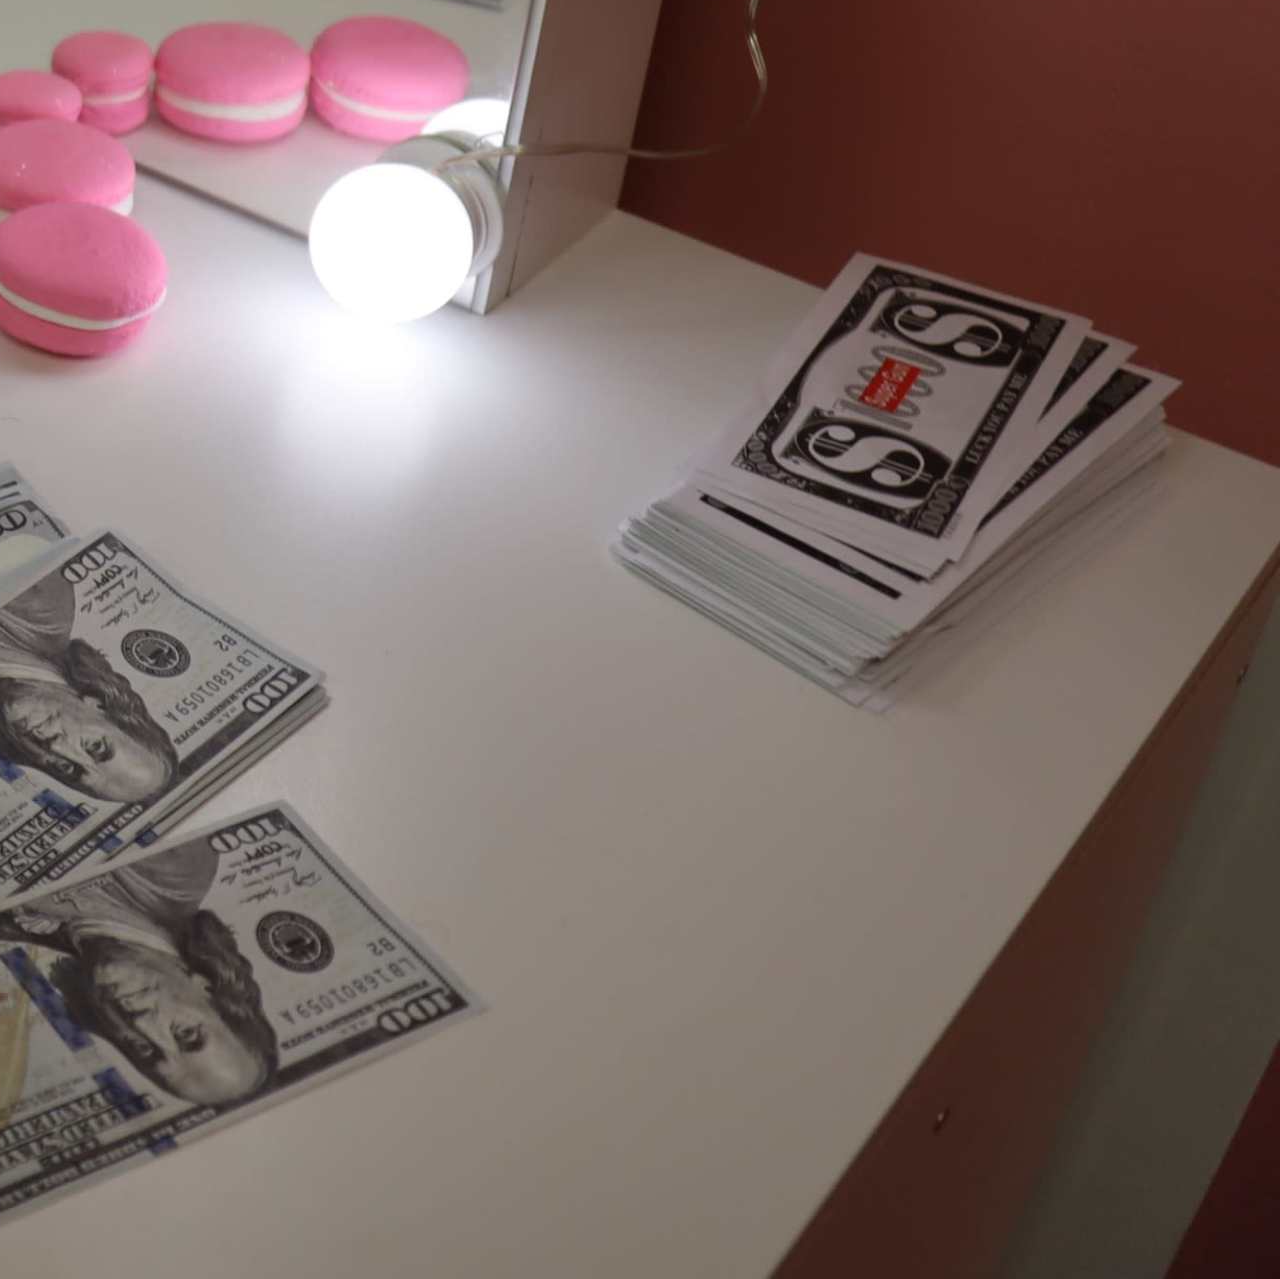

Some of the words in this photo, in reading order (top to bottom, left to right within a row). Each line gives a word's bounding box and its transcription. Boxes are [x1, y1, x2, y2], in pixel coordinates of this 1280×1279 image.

[54, 540, 121, 586] 100
[88, 563, 124, 588] COPY
[211, 633, 239, 653] B2
[238, 667, 302, 716] 100
[203, 815, 282, 855] 100
[241, 839, 284, 862] COPY
[364, 936, 395, 957] B2
[370, 987, 458, 1036] 100
